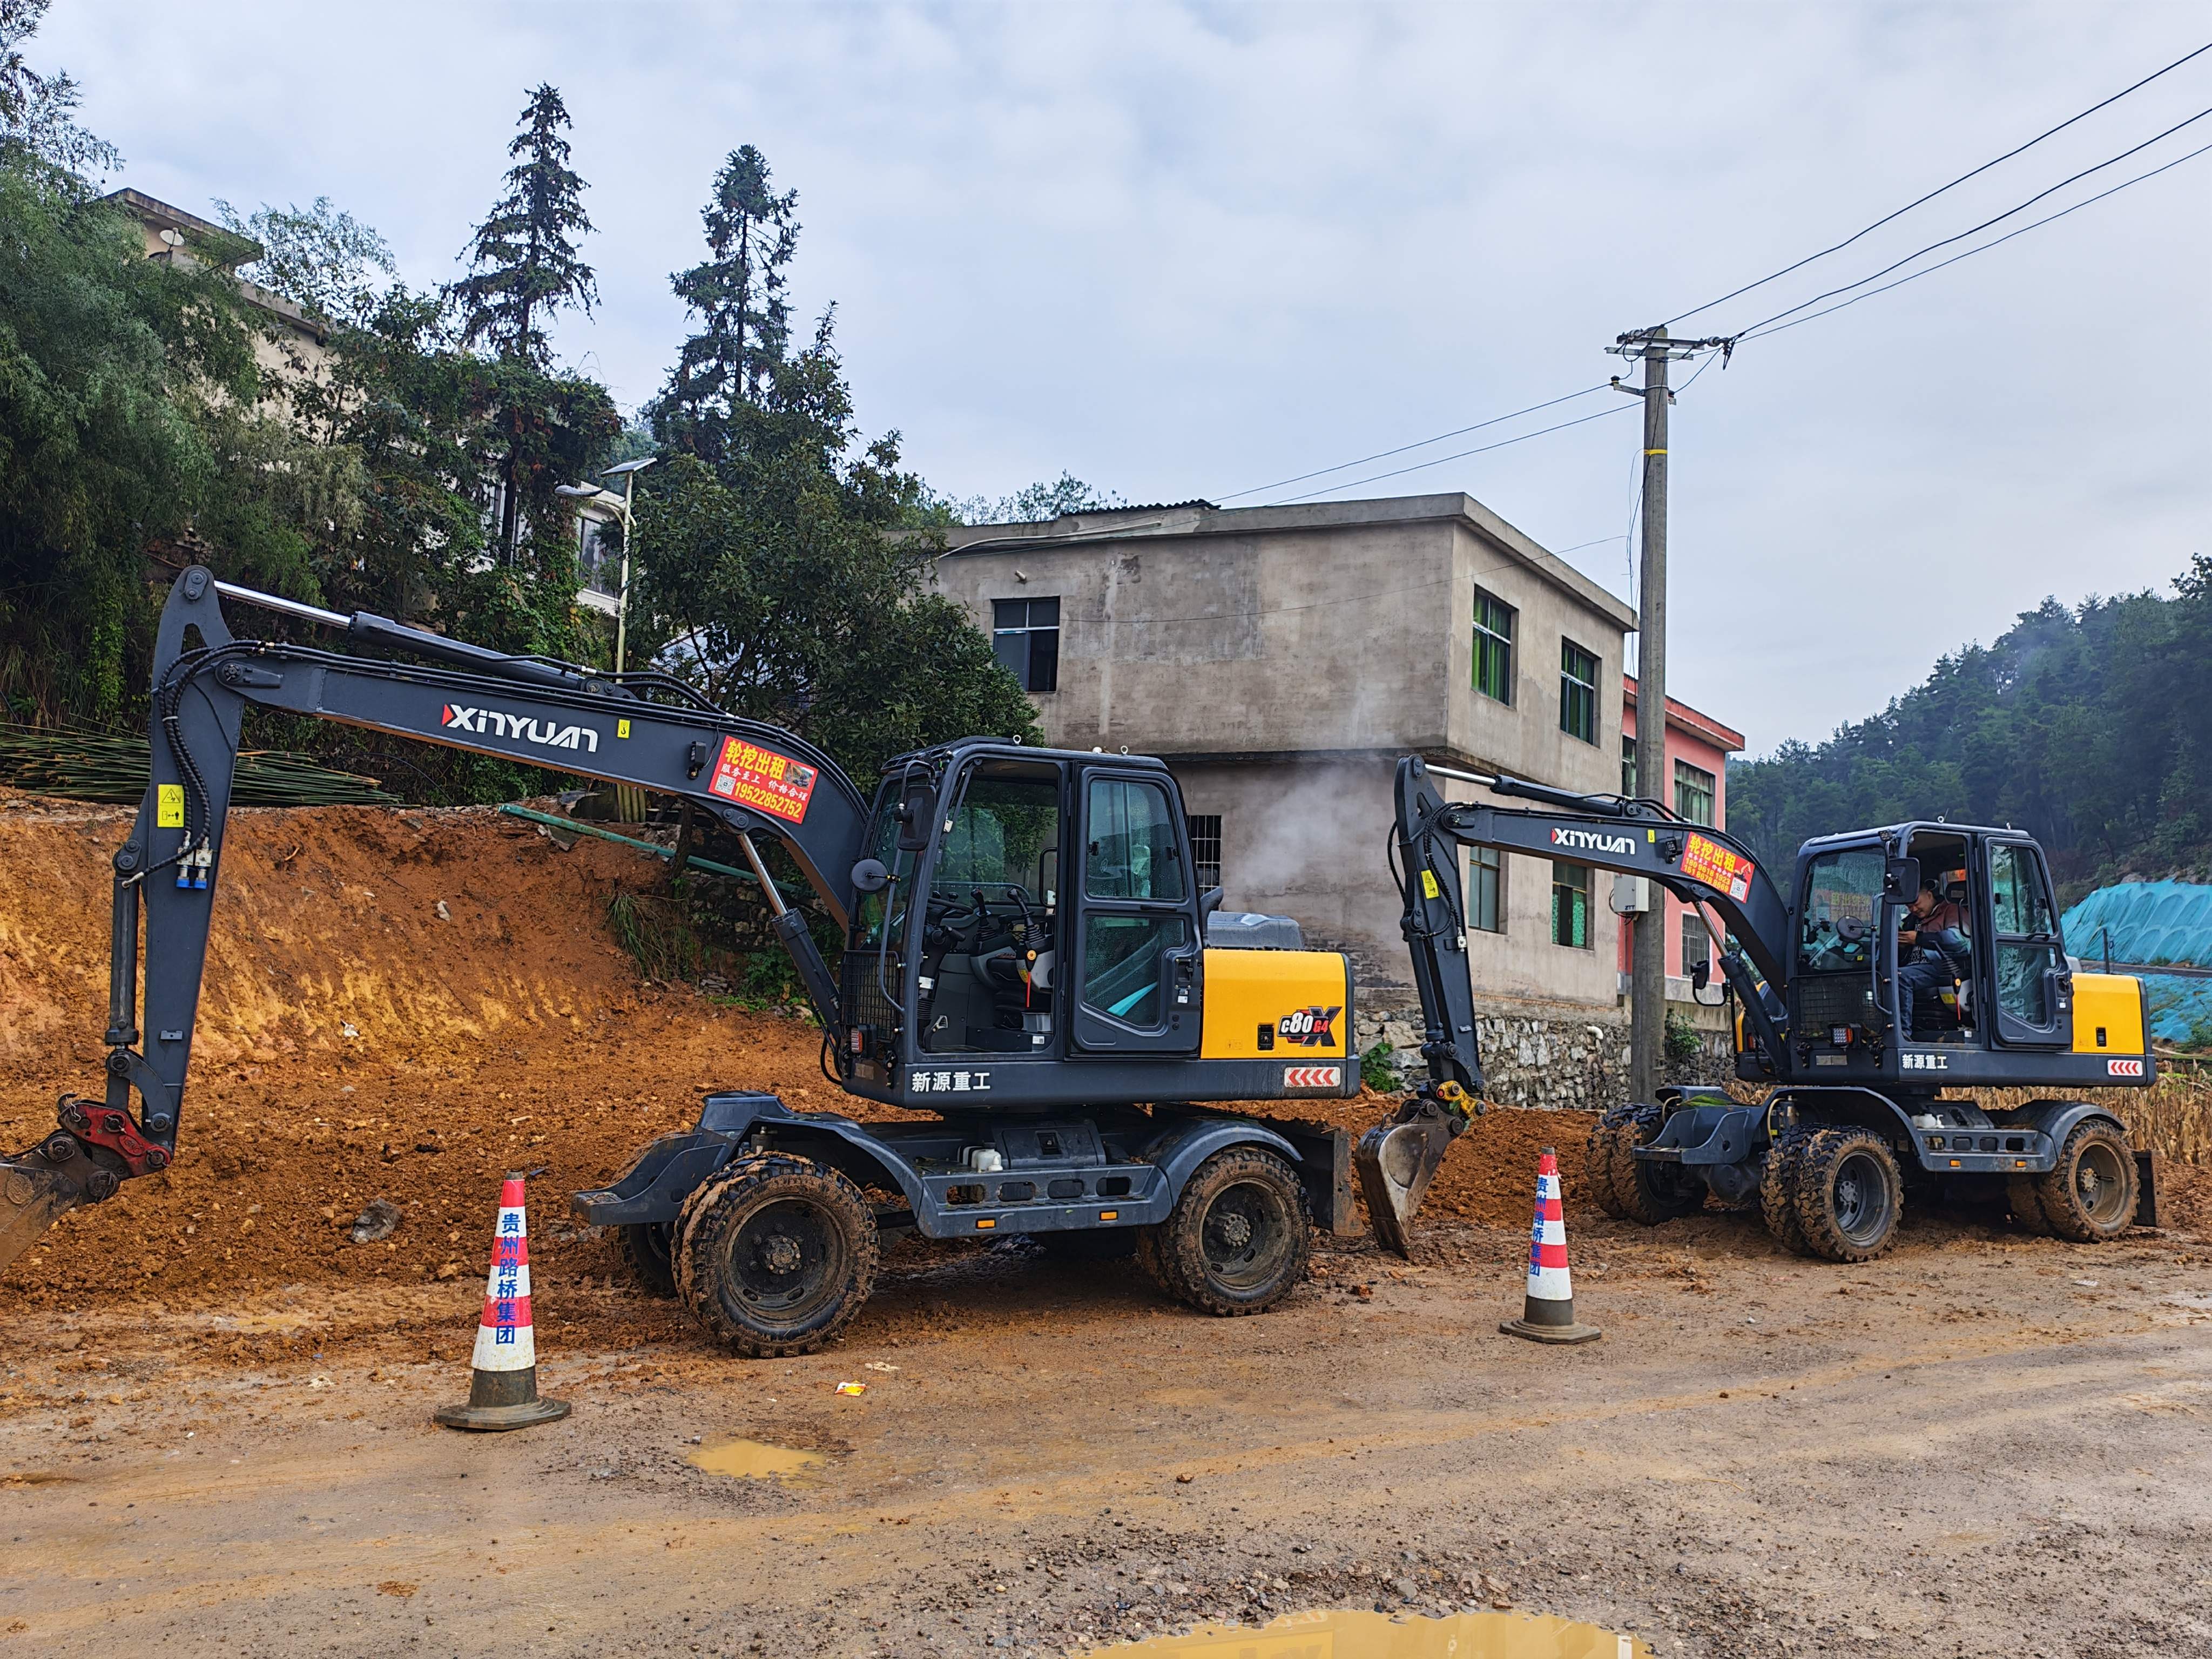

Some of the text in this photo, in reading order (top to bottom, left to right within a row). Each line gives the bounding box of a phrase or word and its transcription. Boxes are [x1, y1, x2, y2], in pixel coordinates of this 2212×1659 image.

[725, 740, 786, 780] 轮挖出租
[720, 763, 808, 801] 服务至上 价格合理
[734, 781, 802, 818] 19522852752
[1684, 865, 1696, 875] 151
[1685, 858, 1697, 868] 180
[1716, 873, 1731, 885] 1923
[1689, 835, 1736, 873] 轮挖出租
[1902, 1054, 1948, 1069] 新源重工
[912, 1071, 991, 1092] 新源重工
[495, 1212, 521, 1345] 贵州路桥集团
